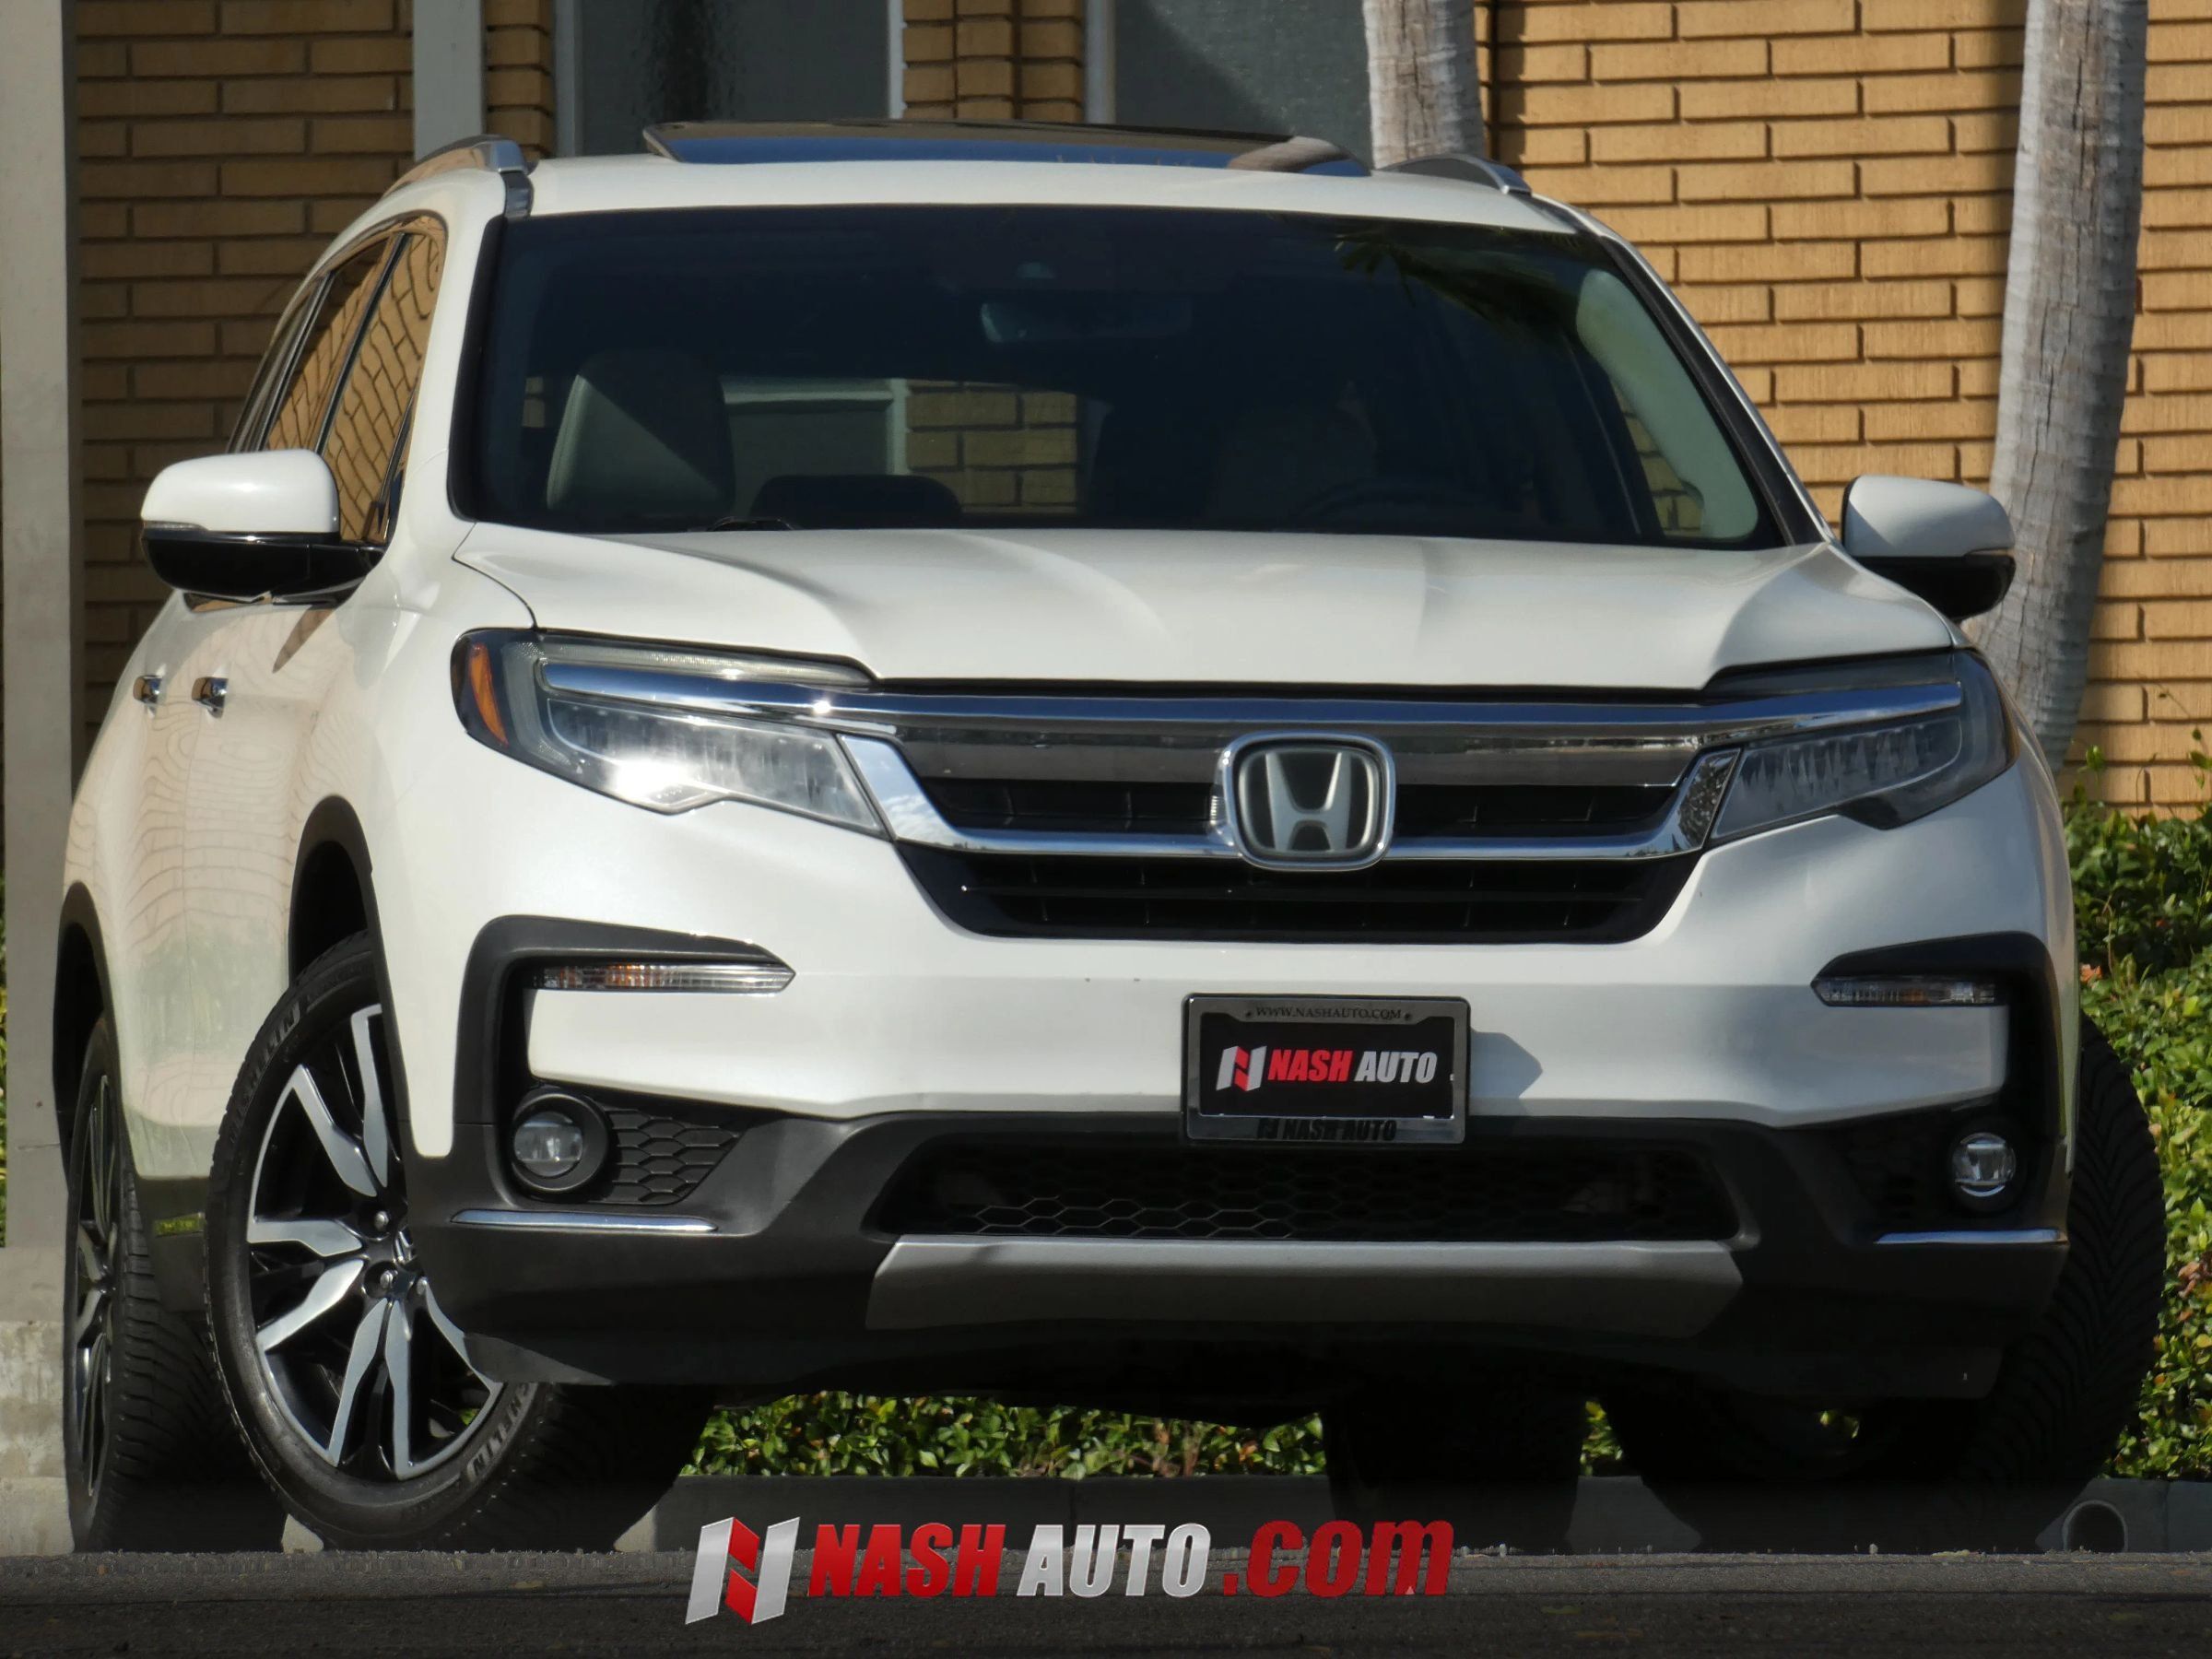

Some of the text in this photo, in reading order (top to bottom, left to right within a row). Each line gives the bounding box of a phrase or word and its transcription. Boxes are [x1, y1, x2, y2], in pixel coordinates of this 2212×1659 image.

[1255, 1006, 1402, 1021] WWW.NASHAUTO.COM
[1267, 1048, 1354, 1083] NASH
[1353, 1050, 1438, 1084] AUTO
[1282, 1118, 1340, 1140] NASH
[1341, 1119, 1397, 1141] AUTO
